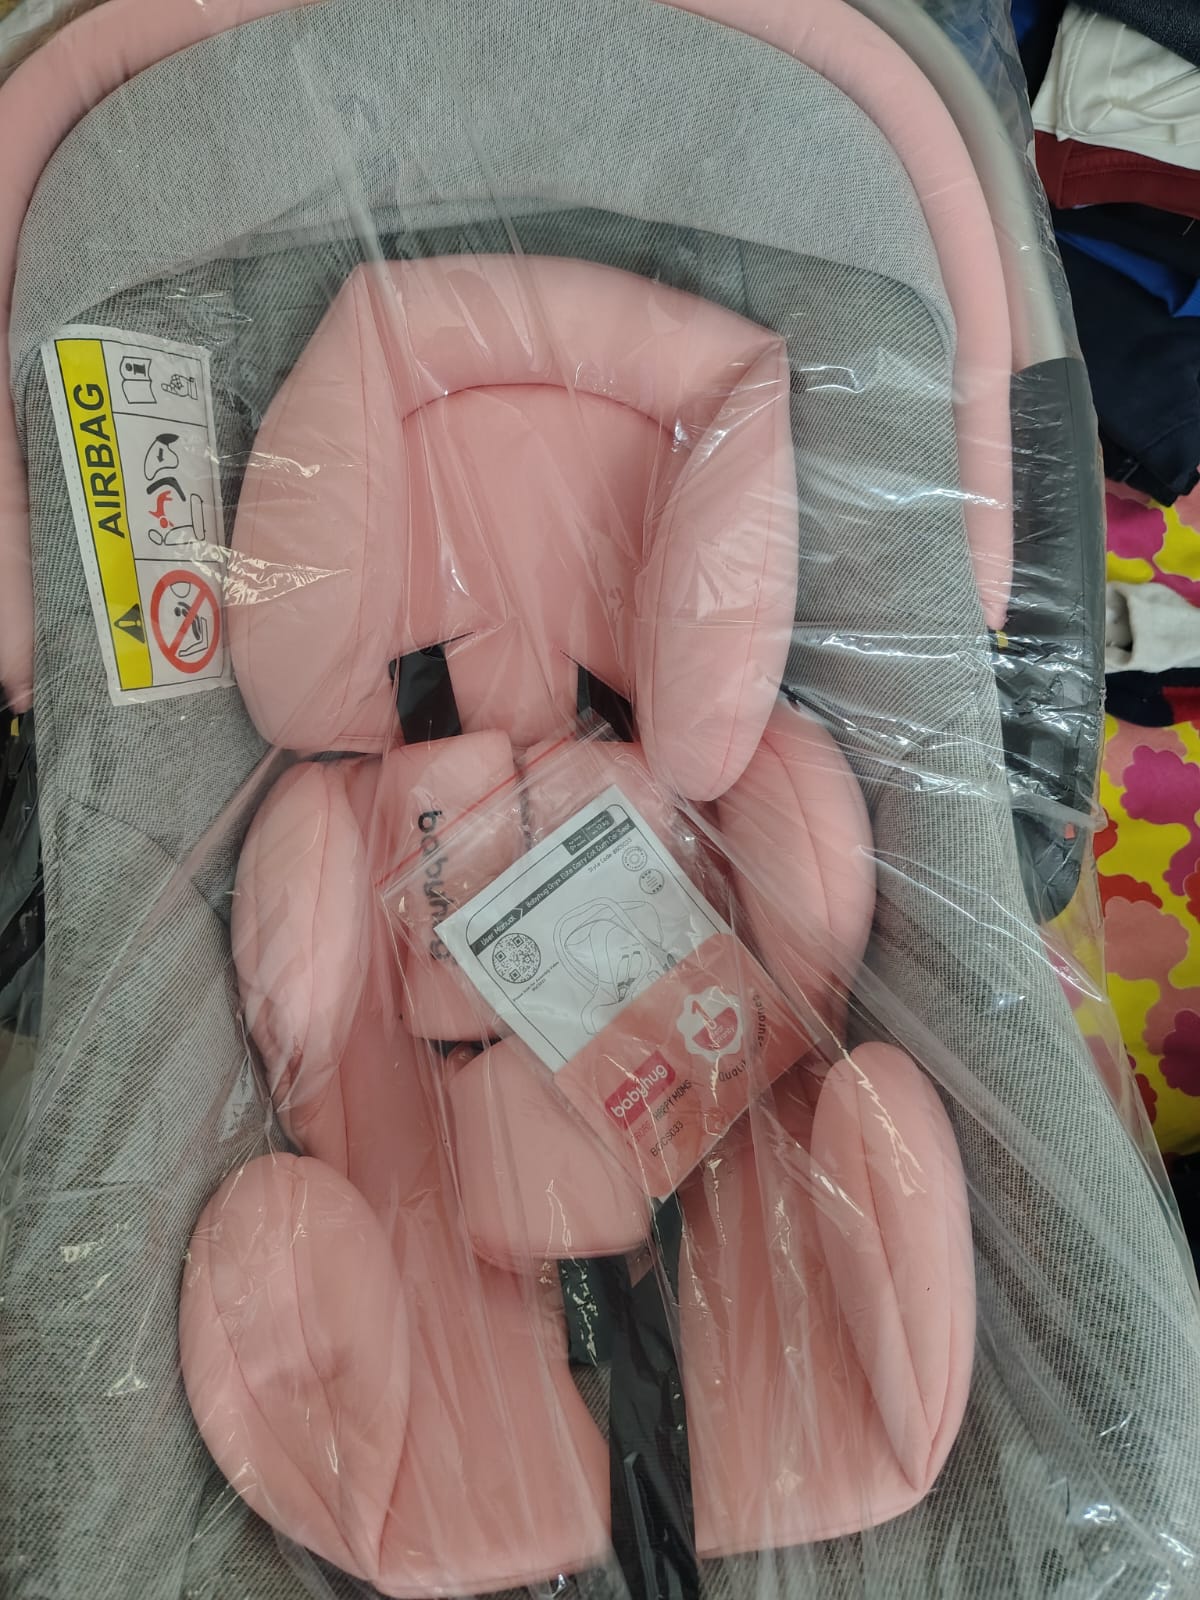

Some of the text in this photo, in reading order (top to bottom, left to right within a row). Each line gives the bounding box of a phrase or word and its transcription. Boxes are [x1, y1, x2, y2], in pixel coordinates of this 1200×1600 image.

[73, 384, 125, 538] AIRBAG
[417, 811, 457, 967] babyhg
[524, 887, 550, 908] Babyhug
[571, 855, 588, 870] Carry
[479, 913, 516, 946] User Manual
[692, 1000, 717, 1029] 1
[610, 1064, 668, 1118] babyhug
[671, 1079, 693, 1103] MOMS
